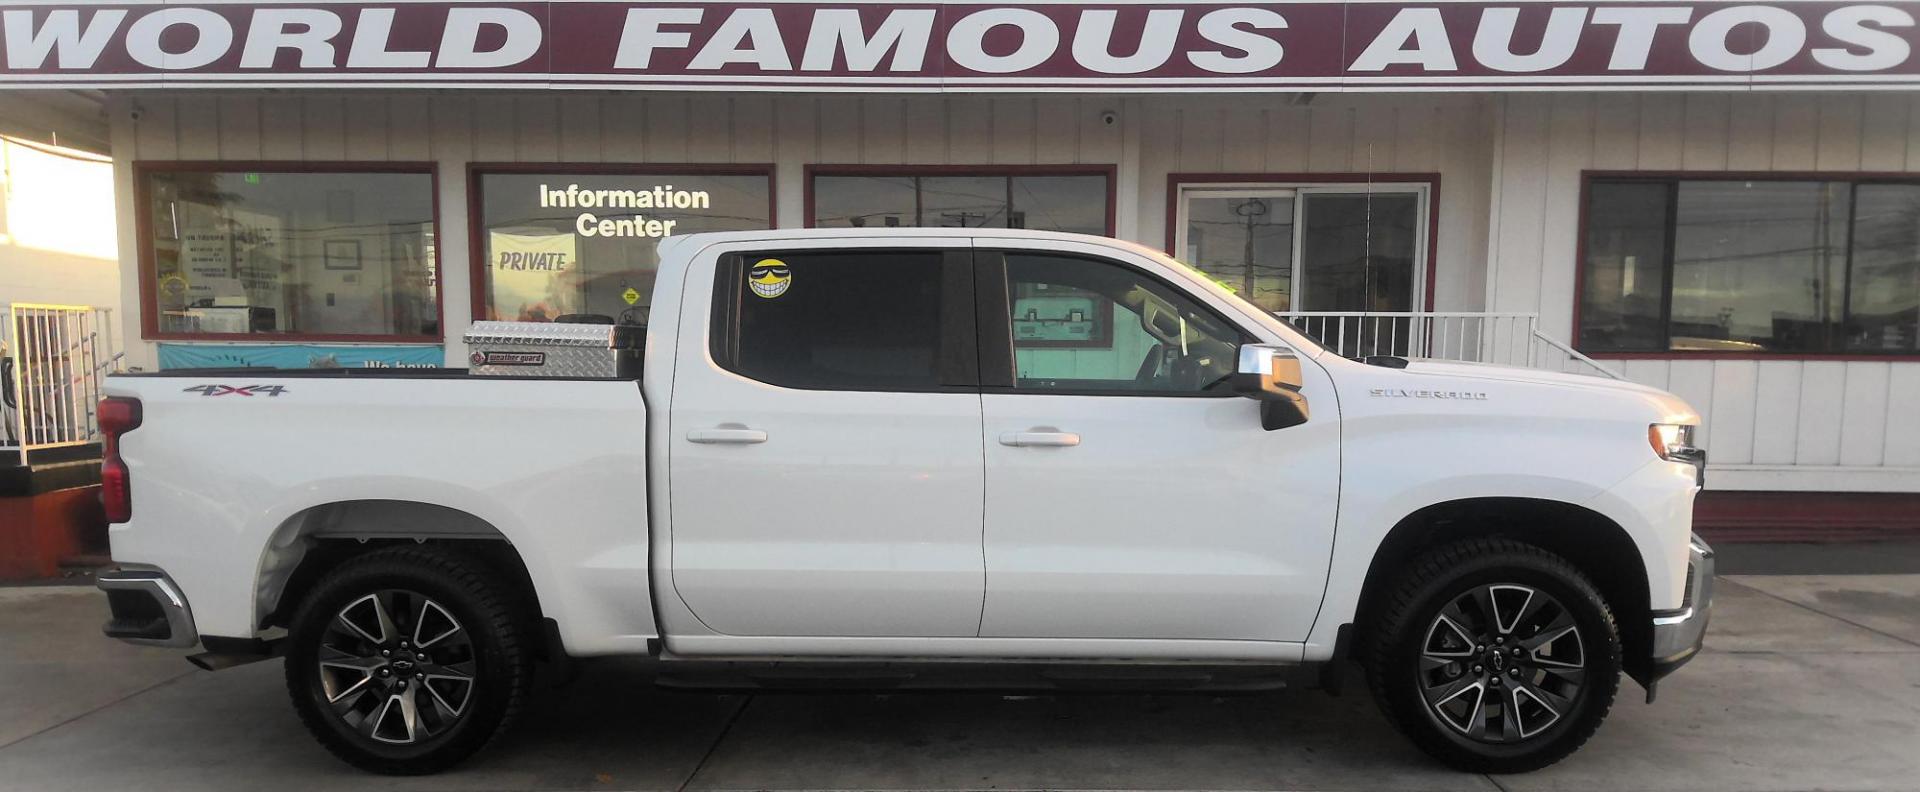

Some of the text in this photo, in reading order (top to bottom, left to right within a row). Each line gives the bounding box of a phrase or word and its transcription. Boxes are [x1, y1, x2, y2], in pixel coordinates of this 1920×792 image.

[3, 6, 1917, 74] WORLD FAMOUS AUTOS
[539, 184, 710, 209] Information
[576, 213, 677, 238] Center
[499, 251, 567, 272] PRIVATE
[1370, 389, 1488, 400] SILVERADO
